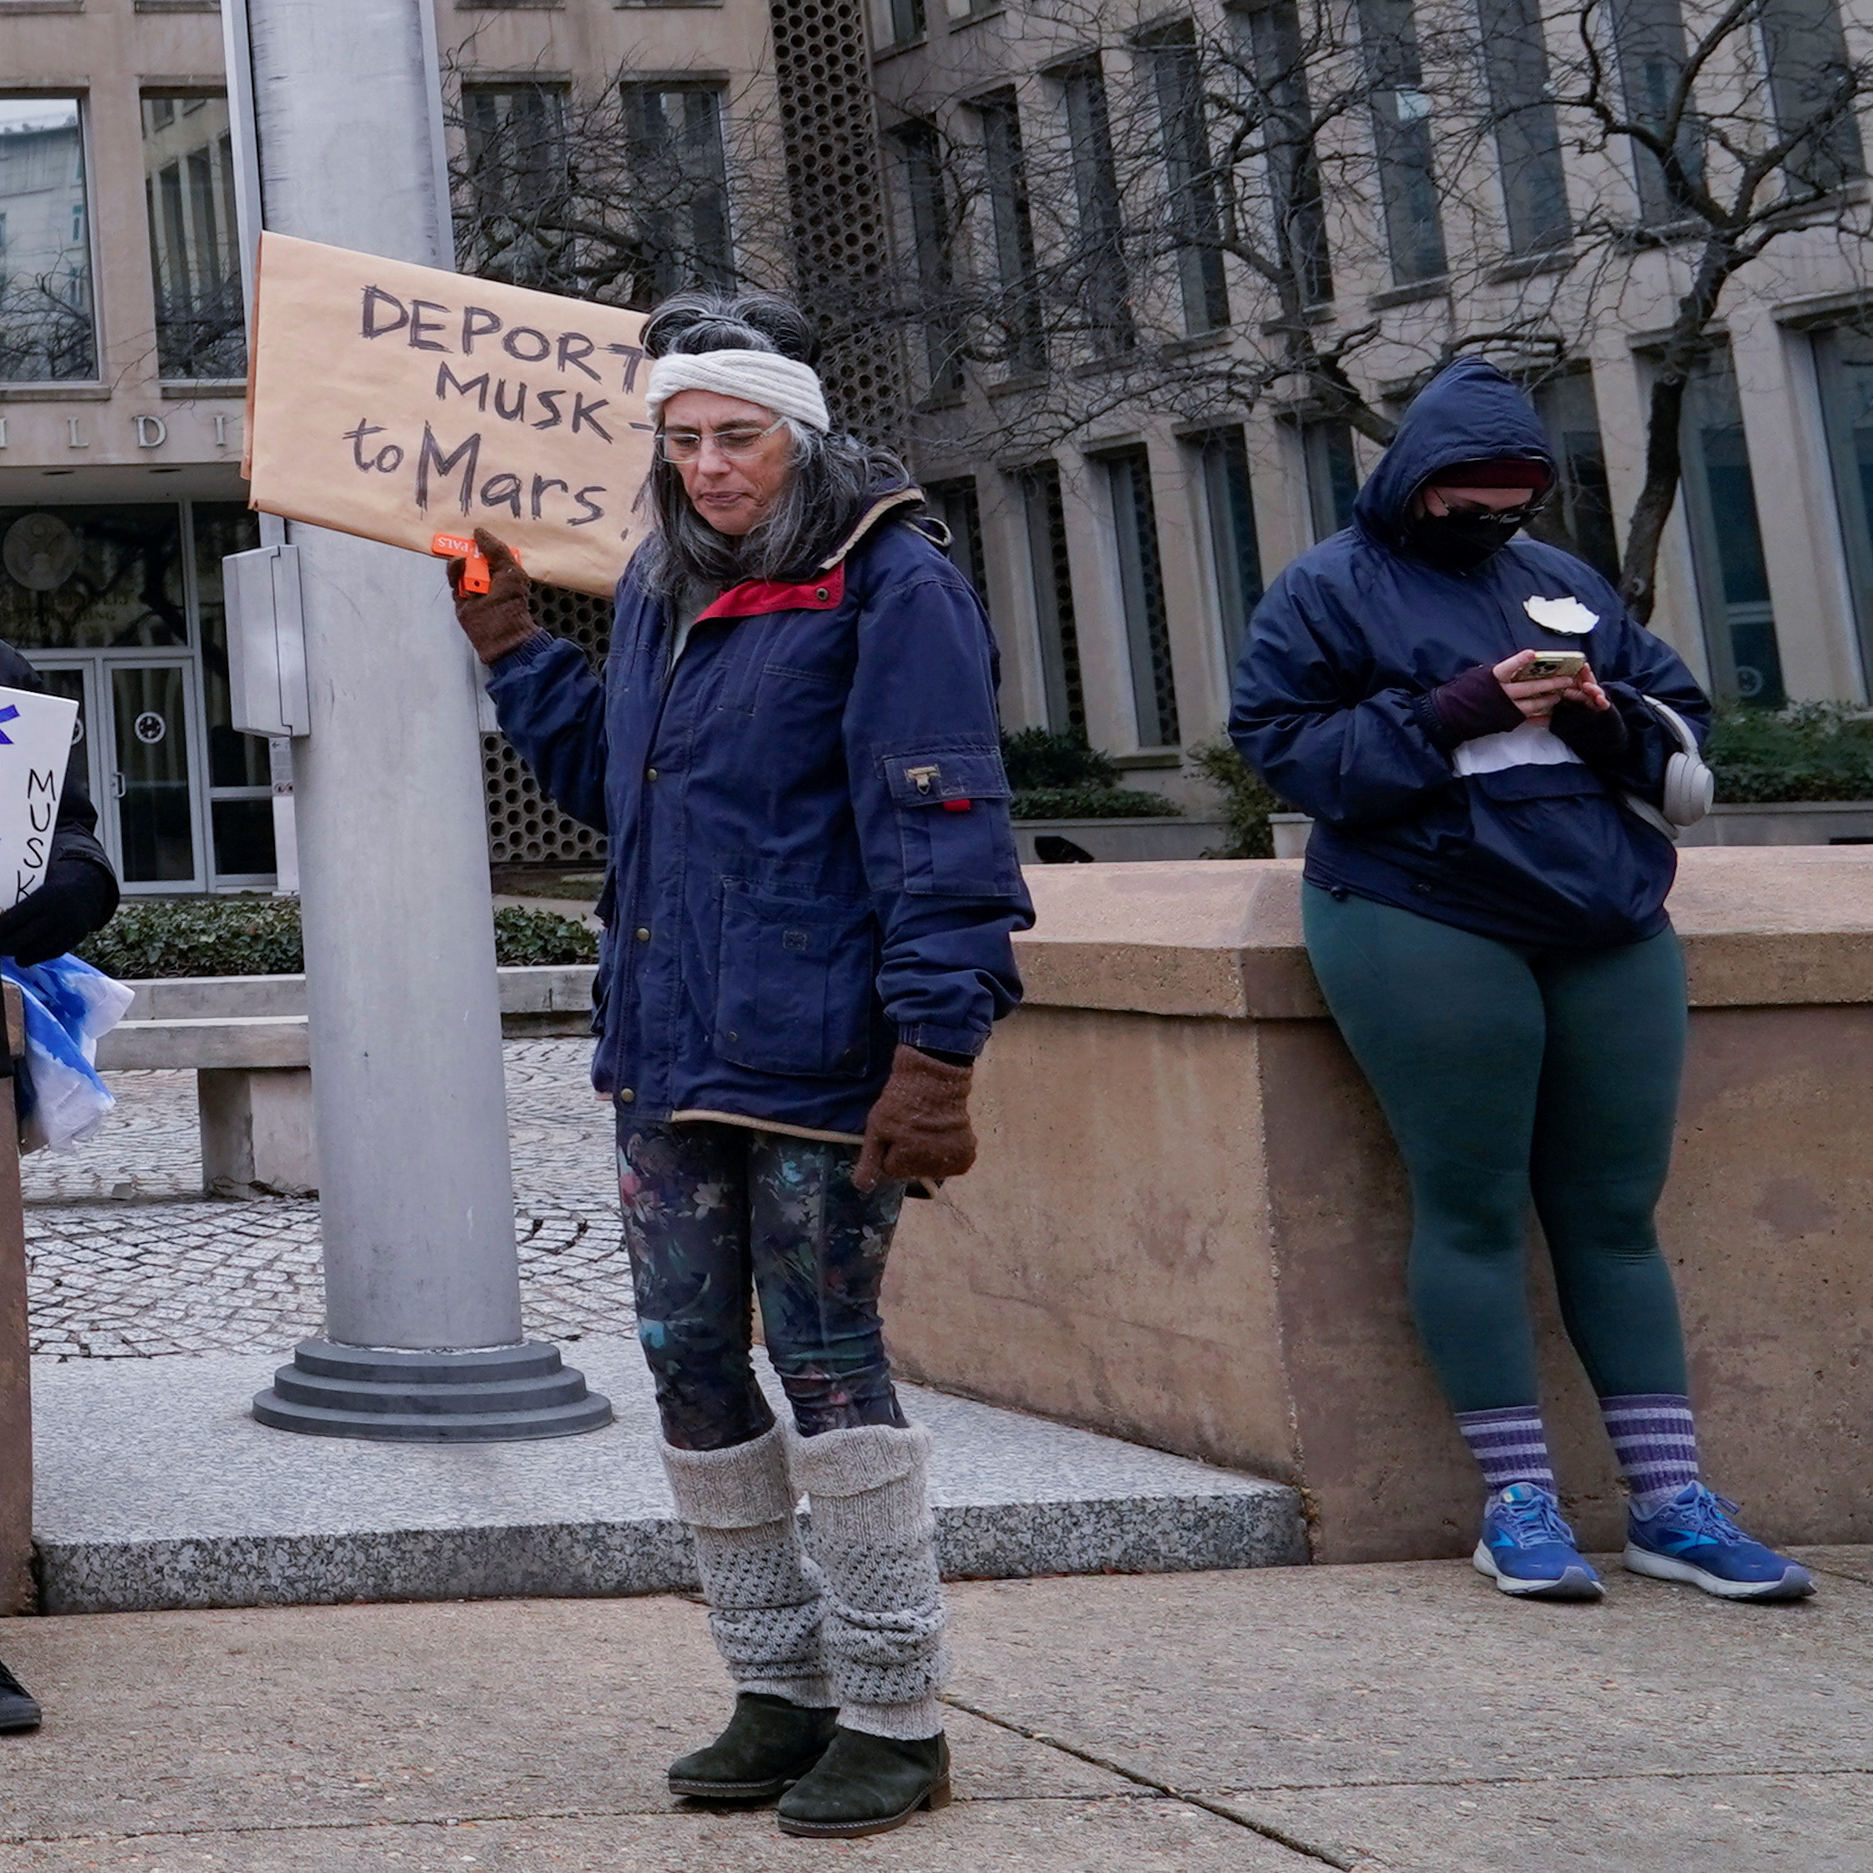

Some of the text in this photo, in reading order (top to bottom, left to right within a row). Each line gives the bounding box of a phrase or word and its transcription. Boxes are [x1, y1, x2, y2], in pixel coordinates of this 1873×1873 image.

[359, 284, 650, 394] DEPORT
[343, 417, 404, 473] to
[435, 360, 613, 445] MUSK
[14, 767, 57, 905] MUSK
